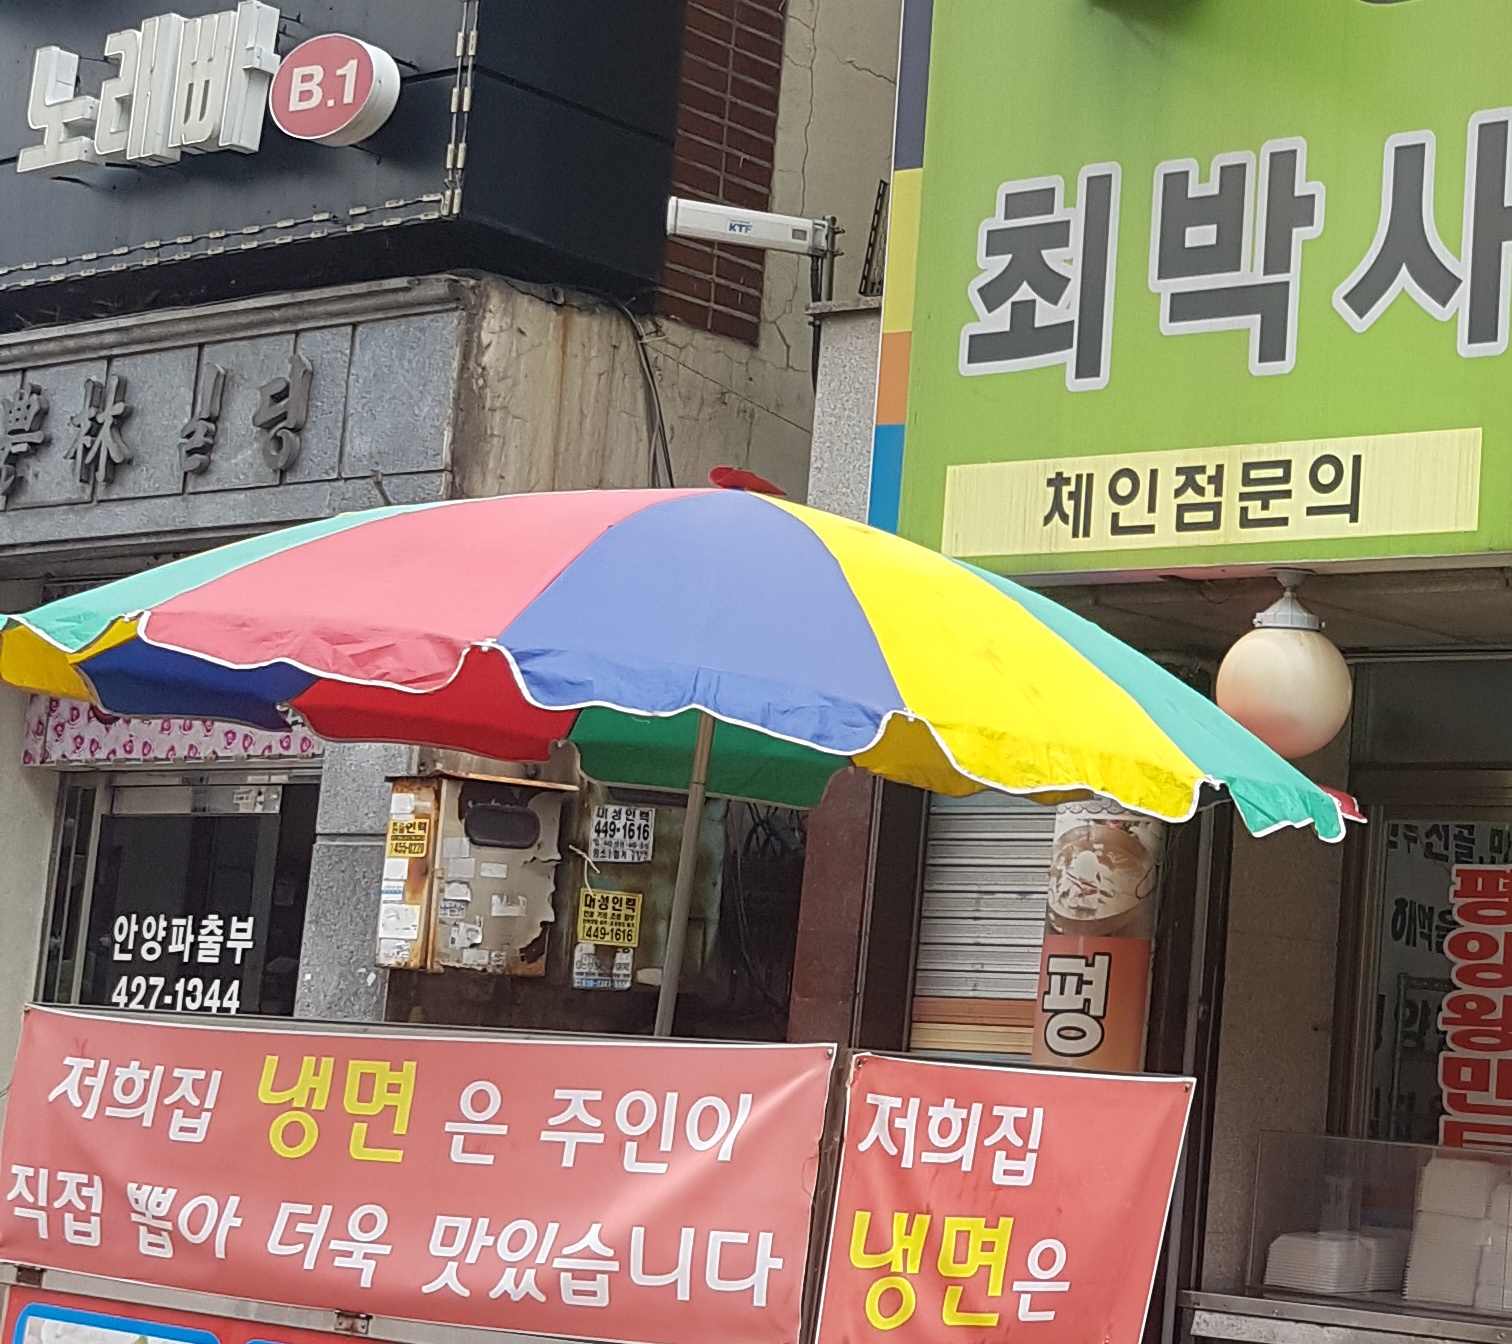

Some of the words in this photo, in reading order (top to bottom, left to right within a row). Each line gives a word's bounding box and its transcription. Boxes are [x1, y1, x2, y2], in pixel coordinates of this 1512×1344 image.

[286, 58, 359, 113] B.1
[1044, 453, 1364, 539] 체인점문의
[112, 914, 255, 964] 안양파출부
[111, 975, 240, 1014] 427-1344
[1042, 952, 1111, 1057] 평
[48, 1054, 223, 1144] 저희집
[257, 1054, 418, 1164] 냉면
[444, 1080, 509, 1166] 은
[539, 1088, 754, 1175] 주인이
[857, 1091, 1046, 1188] 저희집
[4, 1163, 105, 1249] 직접
[125, 1180, 244, 1260] 뽑아
[266, 1202, 393, 1288] 더욱
[420, 1214, 784, 1309] 맛있습니다
[847, 1210, 1072, 1331] 냉면은
